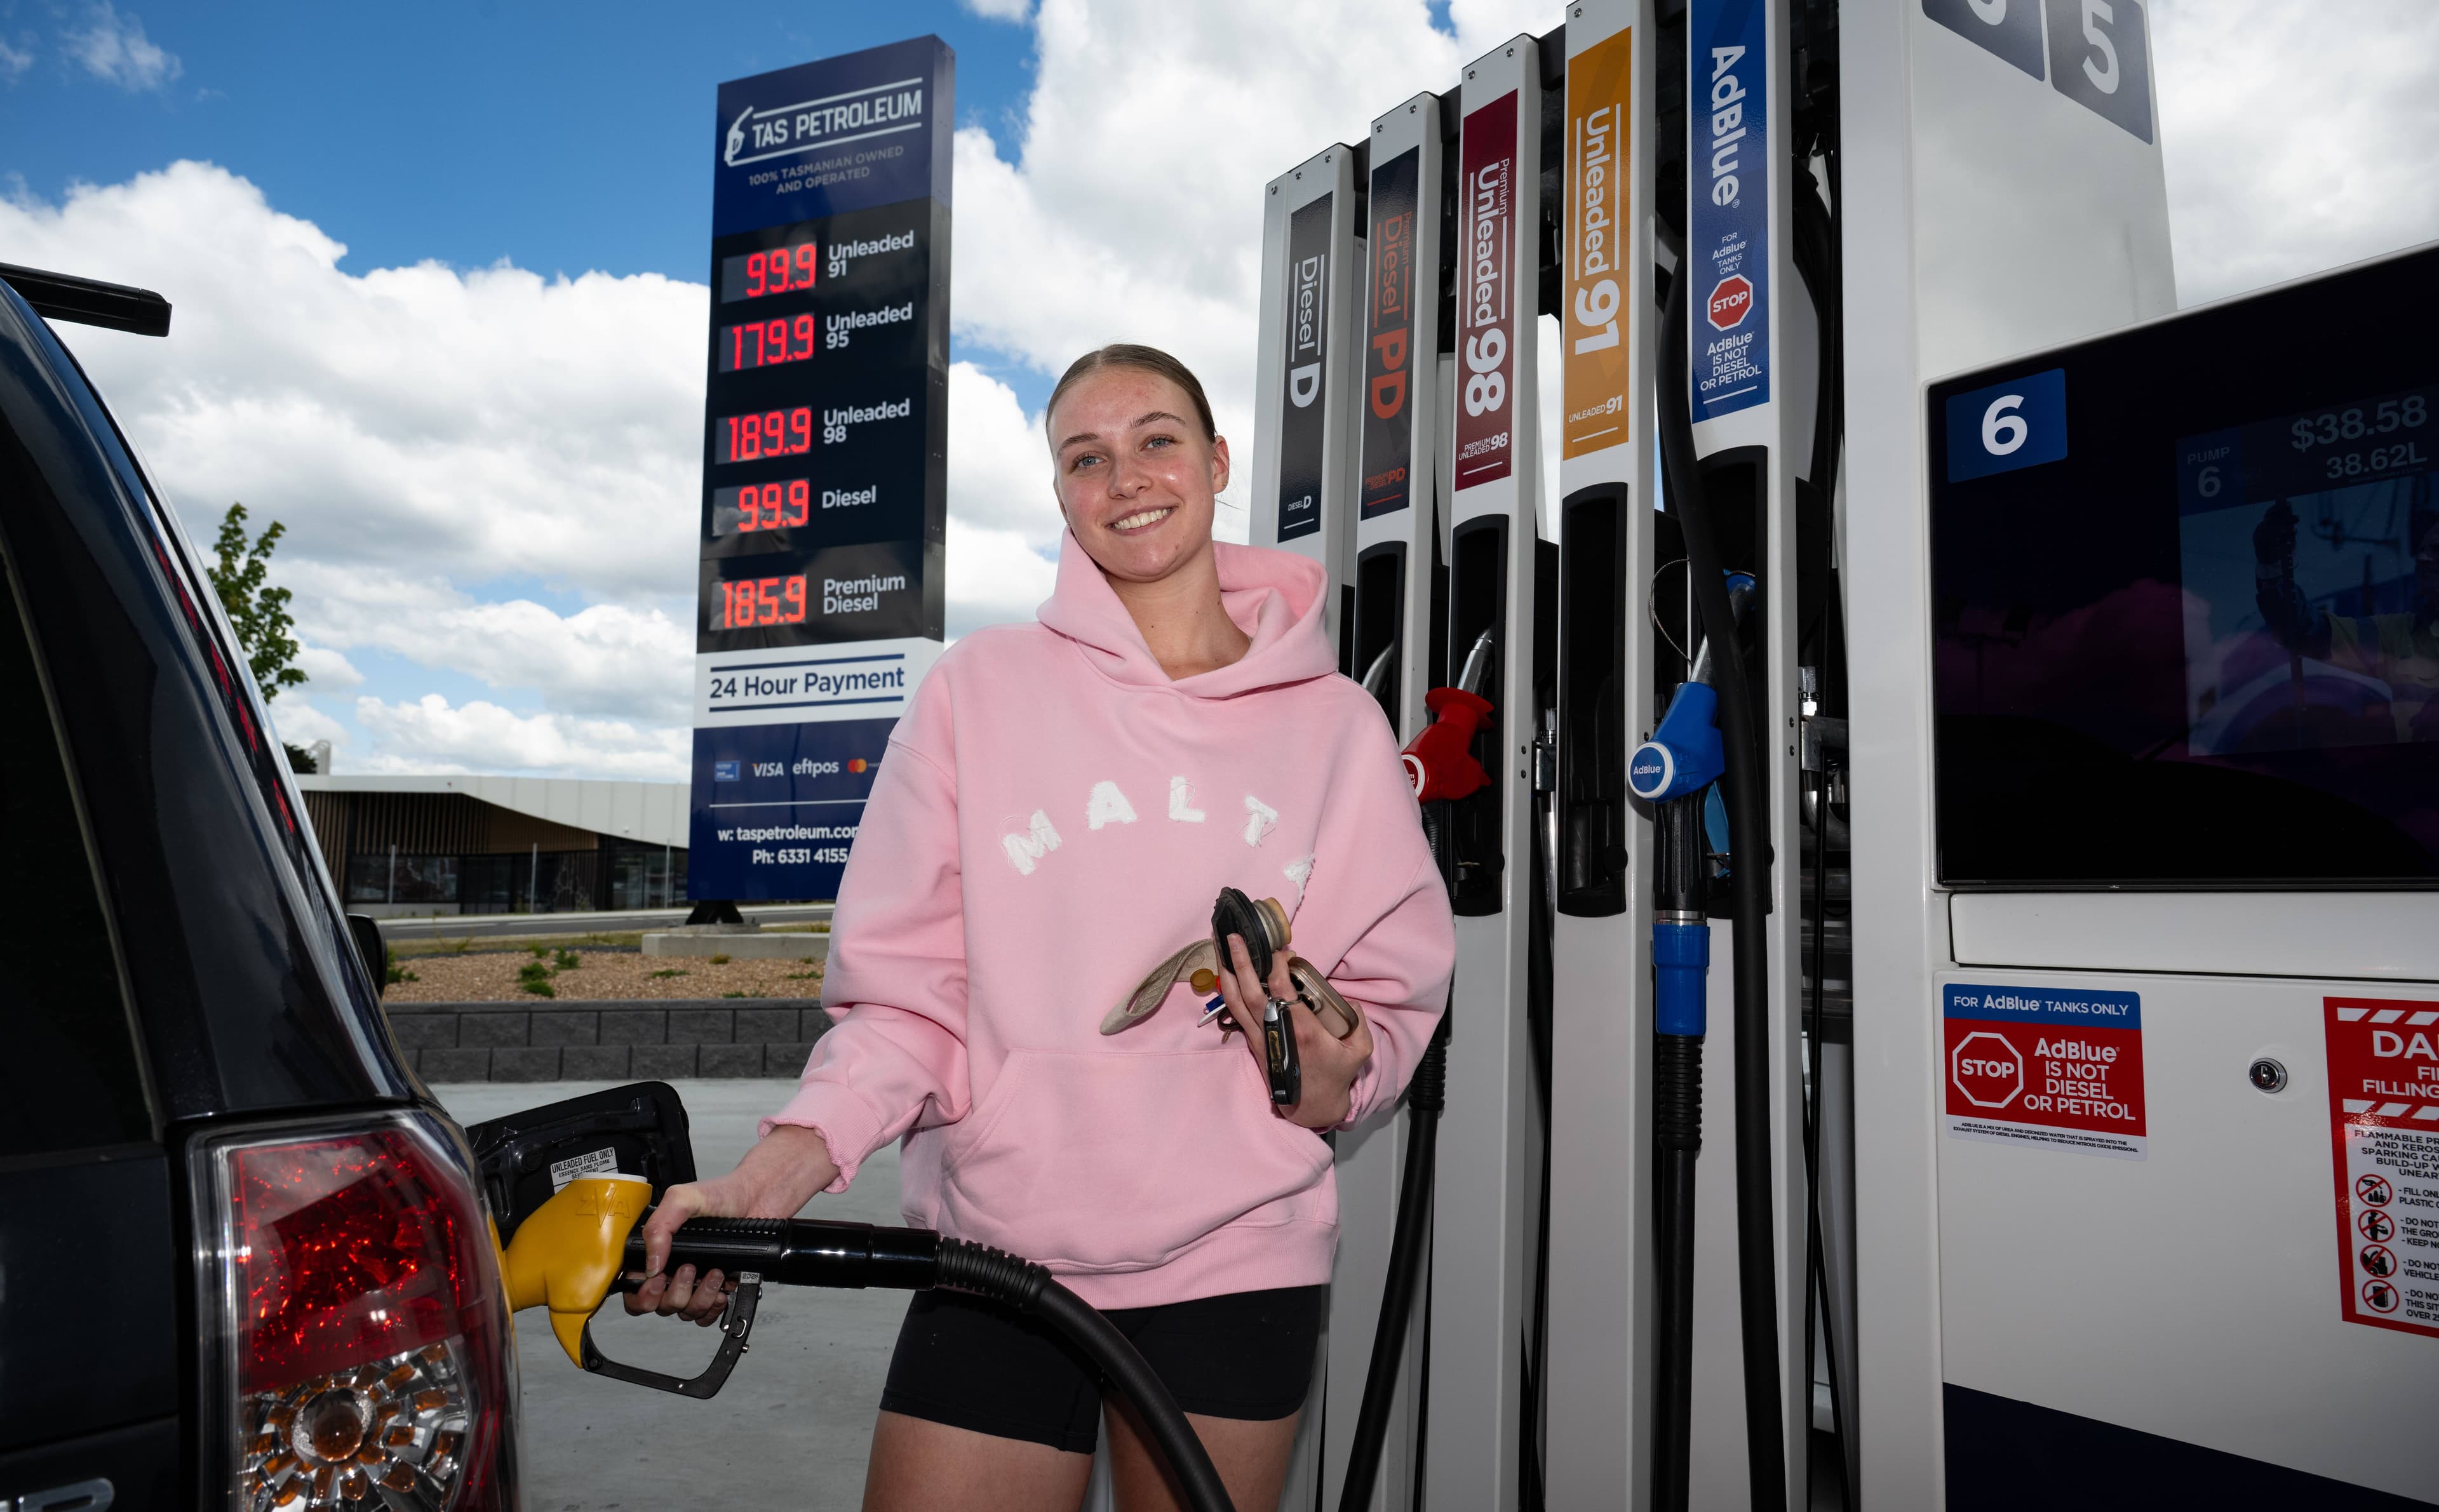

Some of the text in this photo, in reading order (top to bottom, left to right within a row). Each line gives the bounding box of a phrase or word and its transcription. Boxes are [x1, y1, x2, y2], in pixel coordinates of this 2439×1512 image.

[2081, 0, 2120, 95] 5
[752, 90, 922, 149] TAS PETROLEUM
[748, 145, 904, 186] 100% TASMANIAN OWNED
[776, 166, 870, 195] AND OPERATED
[1500, 157, 1509, 215] Premium
[1585, 106, 1610, 276] Unleaded
[828, 230, 914, 261] Unleaded
[1402, 211, 1413, 265] Premium
[1475, 162, 1500, 328] Unleaded
[1722, 232, 1738, 244] FOR
[746, 243, 816, 297] 99.9
[828, 260, 847, 278] 91
[1382, 215, 1403, 314] Diesel
[1717, 253, 1742, 268] TANKS
[1719, 262, 1740, 275] ONLY
[1300, 256, 1318, 350] Diesel
[1713, 291, 1748, 313] STOP
[826, 302, 913, 332] Unleaded
[1575, 279, 1620, 355] 91
[732, 314, 814, 370] 179.9
[826, 330, 849, 349] 95
[1713, 345, 1749, 365] IS NOT
[1371, 327, 1407, 420] PD
[1465, 328, 1507, 417] 98
[1700, 365, 1762, 391] OR PETROL
[1713, 359, 1750, 377] DIESEL
[1289, 362, 1320, 408] D
[823, 398, 910, 427] Unleaded
[1568, 394, 1623, 422] UNLEADED 91
[729, 407, 812, 462] 189.9
[823, 425, 847, 444] 98
[1982, 394, 2028, 455] 6
[2291, 395, 2427, 453] $38.58
[1458, 445, 1490, 460] UNLEADED
[1464, 432, 1508, 452] PREMIUM 98
[2187, 446, 2230, 464] PUMP
[2327, 442, 2428, 479] 38.62L
[1388, 467, 1406, 485] PD
[2198, 466, 2221, 497] 6
[737, 479, 809, 532] 99.9
[822, 485, 877, 509] Diesel
[1303, 495, 1312, 509] D
[823, 574, 905, 596] Premium
[722, 575, 807, 628] 185.9
[823, 593, 878, 614] Diesel
[710, 667, 905, 699] 24 Hour Payment
[752, 762, 784, 777] VISA
[792, 758, 839, 778] eftpos
[718, 828, 734, 841] w:
[753, 848, 848, 864] Ph: 6331 4155
[1954, 996, 1979, 1007] FOR
[2045, 1001, 2089, 1013] TANKS
[2091, 1003, 2128, 1016] ONLY
[2373, 1030, 2439, 1061] DA
[1961, 1059, 2015, 1078] STOP
[2045, 1060, 2109, 1081] IS NOT
[2417, 1066, 2439, 1081] FI
[2046, 1078, 2114, 1099] DIESEL
[2024, 1094, 2136, 1120] OR PETROL
[2354, 1130, 2422, 1143] FLAMMABLE
[2375, 1141, 2398, 1149] AND
[551, 1148, 613, 1174] UNLEADED FUEL ONLY
[2362, 1147, 2439, 1162] SPARKING CA
[2376, 1158, 2428, 1169] BUILD-UP
[559, 1167, 579, 1178] ESSENCE
[2399, 1168, 2439, 1179] UNEAR
[2399, 1197, 2434, 1208] PLASTIC
[2403, 1188, 2421, 1196] FILL
[2401, 1226, 2439, 1238] THE GRO
[2405, 1217, 2439, 1228] DO NOT
[2407, 1237, 2428, 1247] KEEP
[2408, 1259, 2421, 1268] DO
[2405, 1299, 2425, 1309] THIS
[2410, 1289, 2439, 1301] DO NO
[2407, 1309, 2430, 1320] OVER
